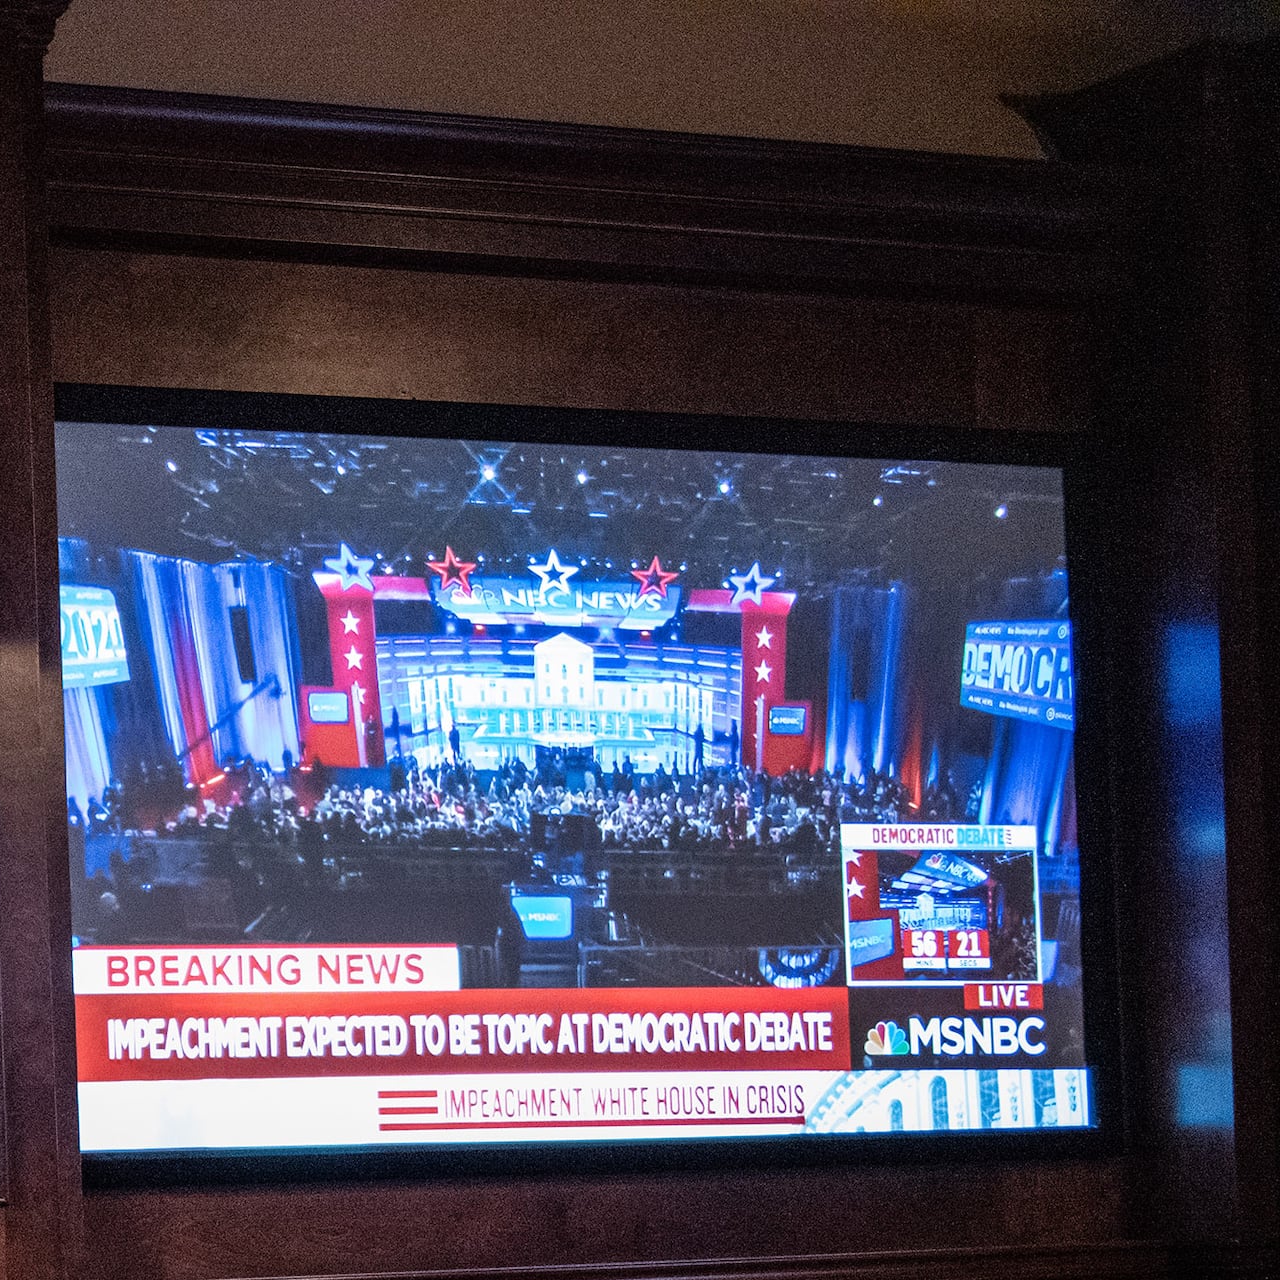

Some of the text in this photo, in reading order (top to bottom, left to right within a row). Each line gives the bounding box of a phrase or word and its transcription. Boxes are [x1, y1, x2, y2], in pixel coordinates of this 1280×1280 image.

[501, 588, 662, 612] NBC NEWS
[872, 828, 1004, 845] DEMOCRATIC DEBATE
[911, 931, 982, 957] 56 21
[107, 954, 424, 986] BREAKING NEWS
[978, 985, 1030, 1007] LIVE
[107, 1012, 833, 1060] IMPEACHMENT EXPECTED TO BE TOPIC AT DEMOCRATIC DEBATE
[909, 1017, 1046, 1055] MSNBC
[591, 1087, 649, 1116] WHITE
[656, 1086, 715, 1115] HOUSE
[723, 1086, 740, 1114] IN
[746, 1085, 805, 1114] CRISIS
